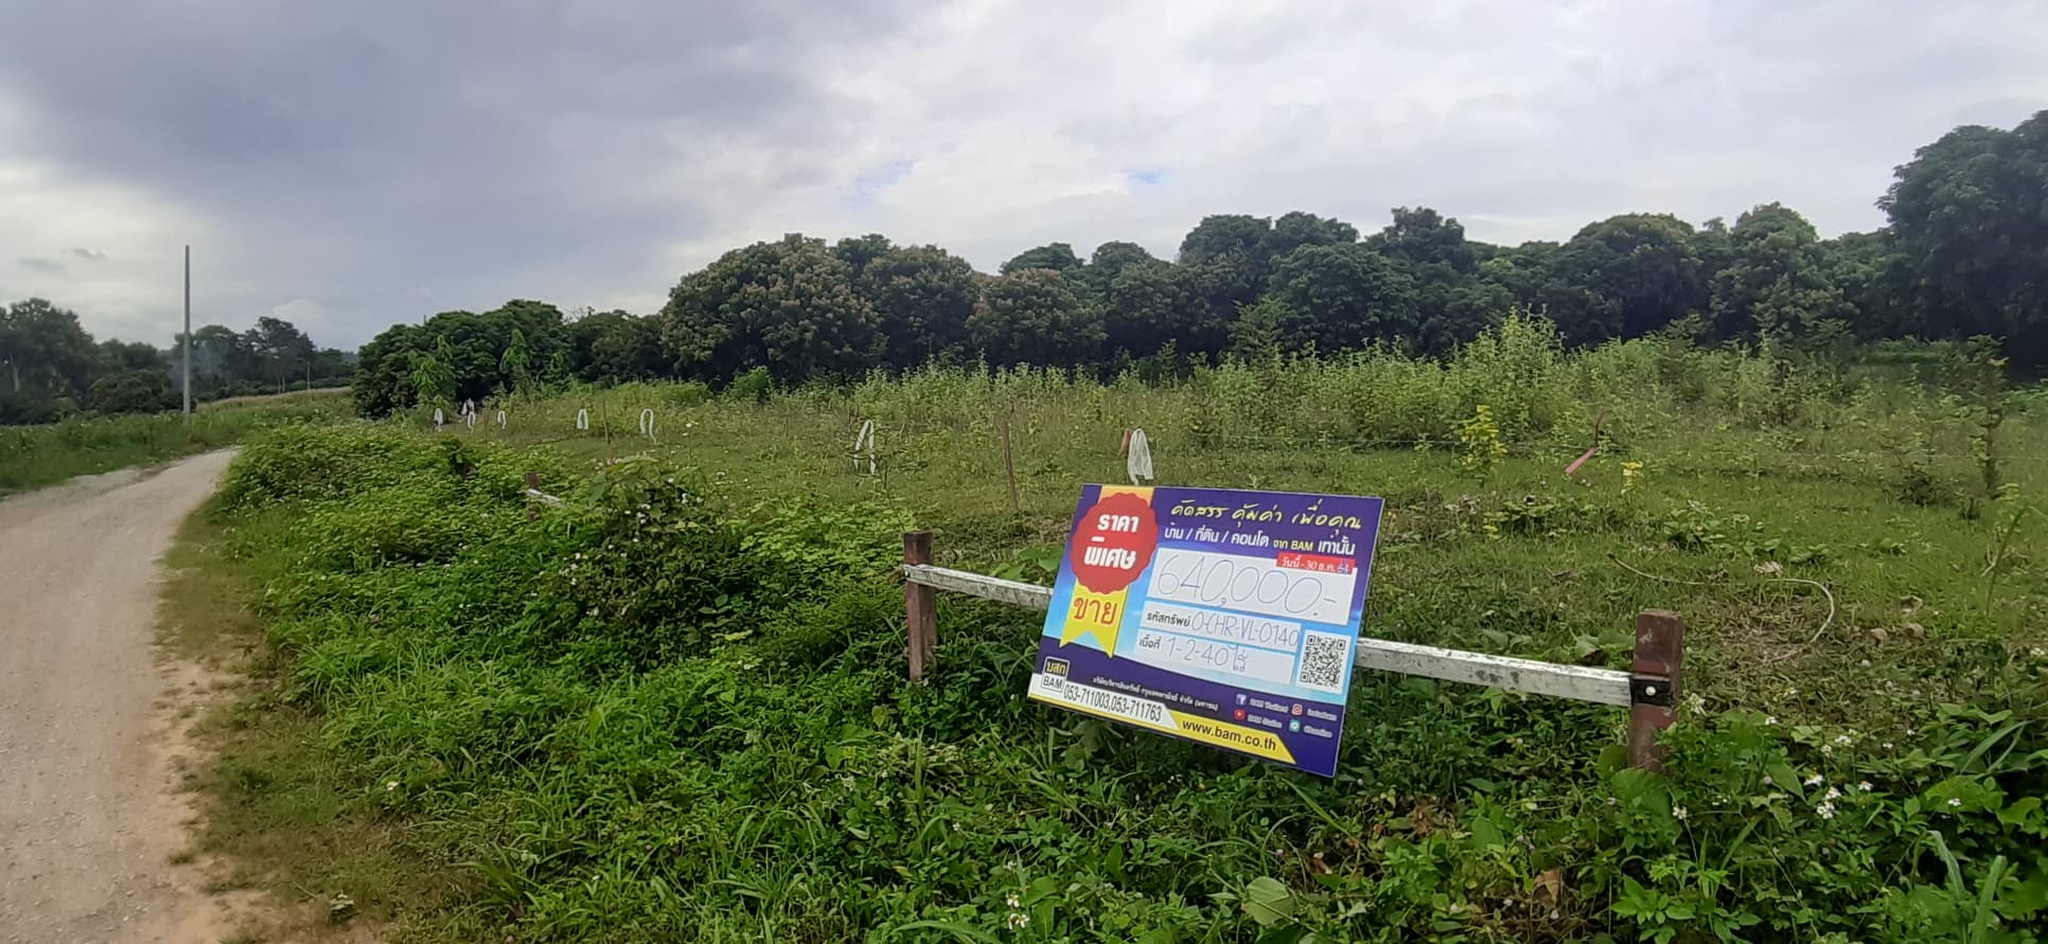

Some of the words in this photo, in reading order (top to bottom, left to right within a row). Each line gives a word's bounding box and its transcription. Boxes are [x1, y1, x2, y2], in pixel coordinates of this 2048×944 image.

[1097, 514, 1140, 533] ราคา
[1231, 503, 1283, 528] คุ้มค่า
[1292, 498, 1362, 535] เพื่อคุณ
[1164, 522, 1184, 540] บ้าน
[1195, 524, 1219, 542] ที่ดิน
[1231, 530, 1269, 548] คอนโด
[1273, 539, 1288, 550] จาก
[1291, 540, 1314, 551] BAM
[1318, 534, 1355, 555] เท่านั้น
[1084, 536, 1137, 570] พิเศษ
[1073, 597, 1118, 625] ขาย
[1146, 611, 1191, 627] รหัสทรัพย์
[1138, 634, 1161, 650] เนื้อที่
[1046, 661, 1066, 676] บสก
[1042, 676, 1063, 690] BAM
[1182, 720, 1277, 751] www.bam.co.th
